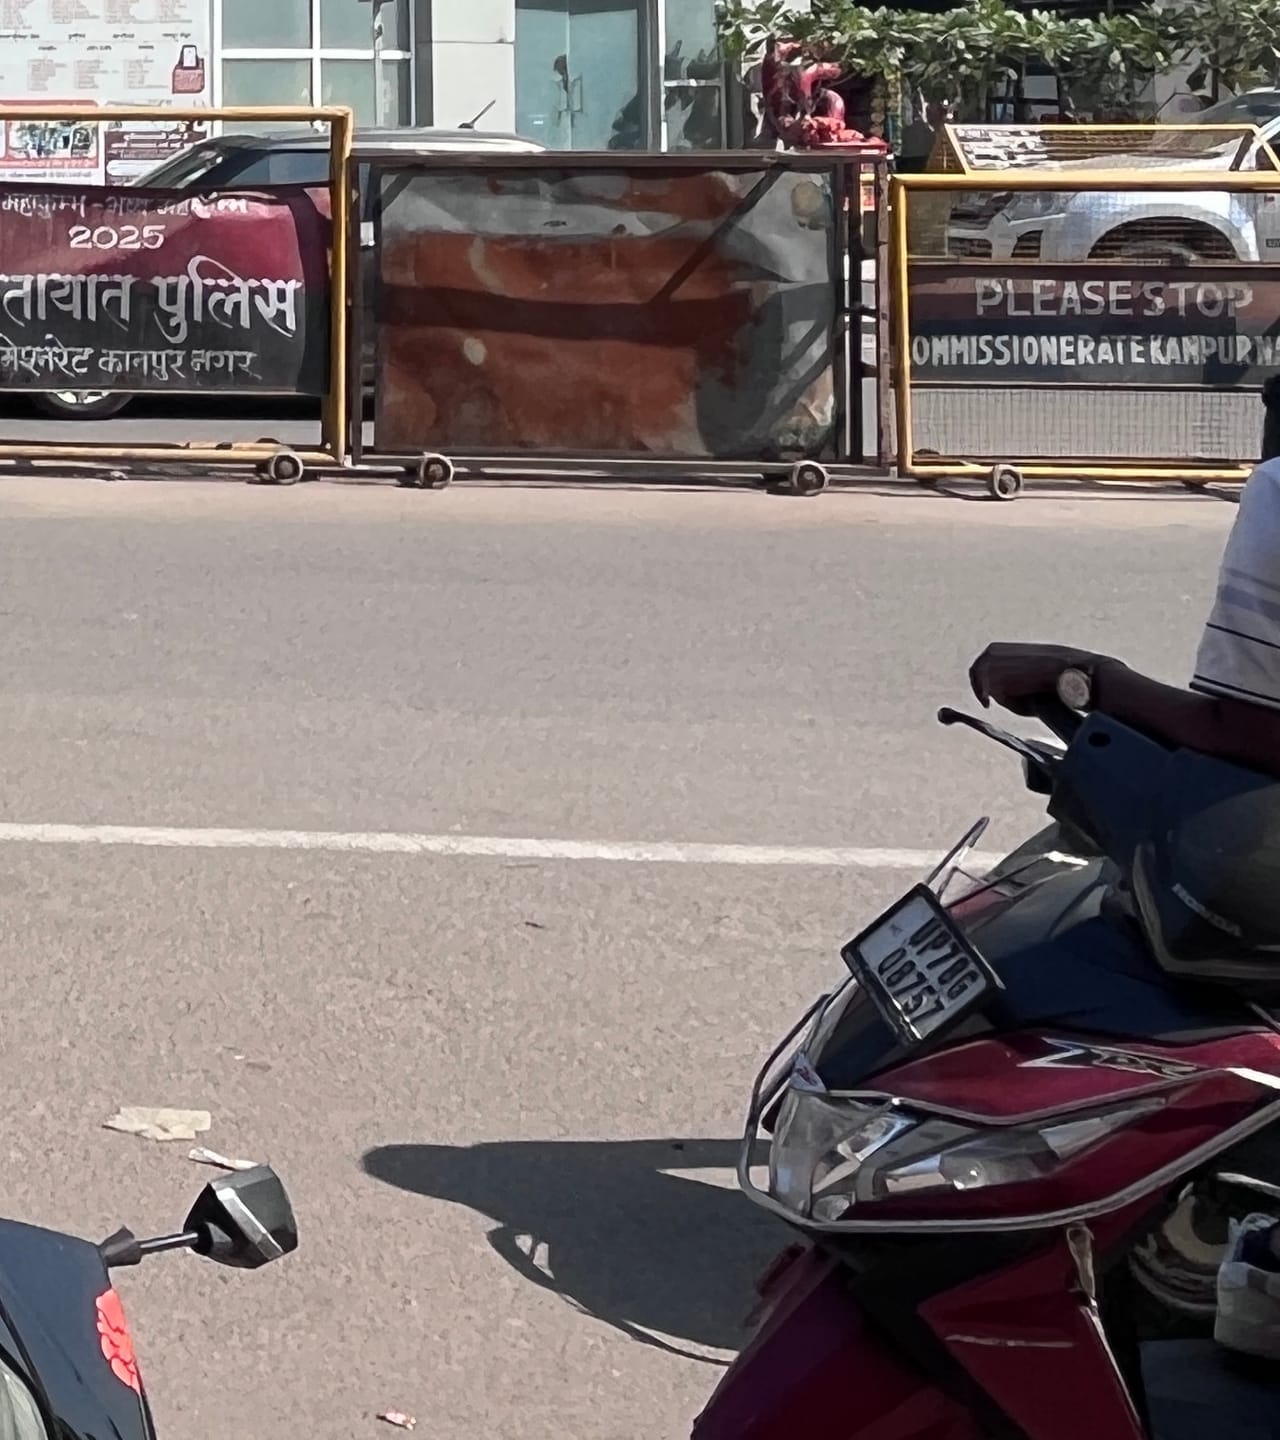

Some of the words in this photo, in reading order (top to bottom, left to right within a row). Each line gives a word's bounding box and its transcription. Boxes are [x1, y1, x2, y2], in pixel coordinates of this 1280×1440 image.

[68, 224, 166, 250] 2025
[148, 255, 303, 344] पुलिस
[975, 277, 1134, 317] PLEASE
[1141, 281, 1254, 318] STOP
[97, 348, 187, 381] कानपुर
[190, 349, 263, 380] नगर
[912, 335, 1148, 367] OMMISSIONERATE
